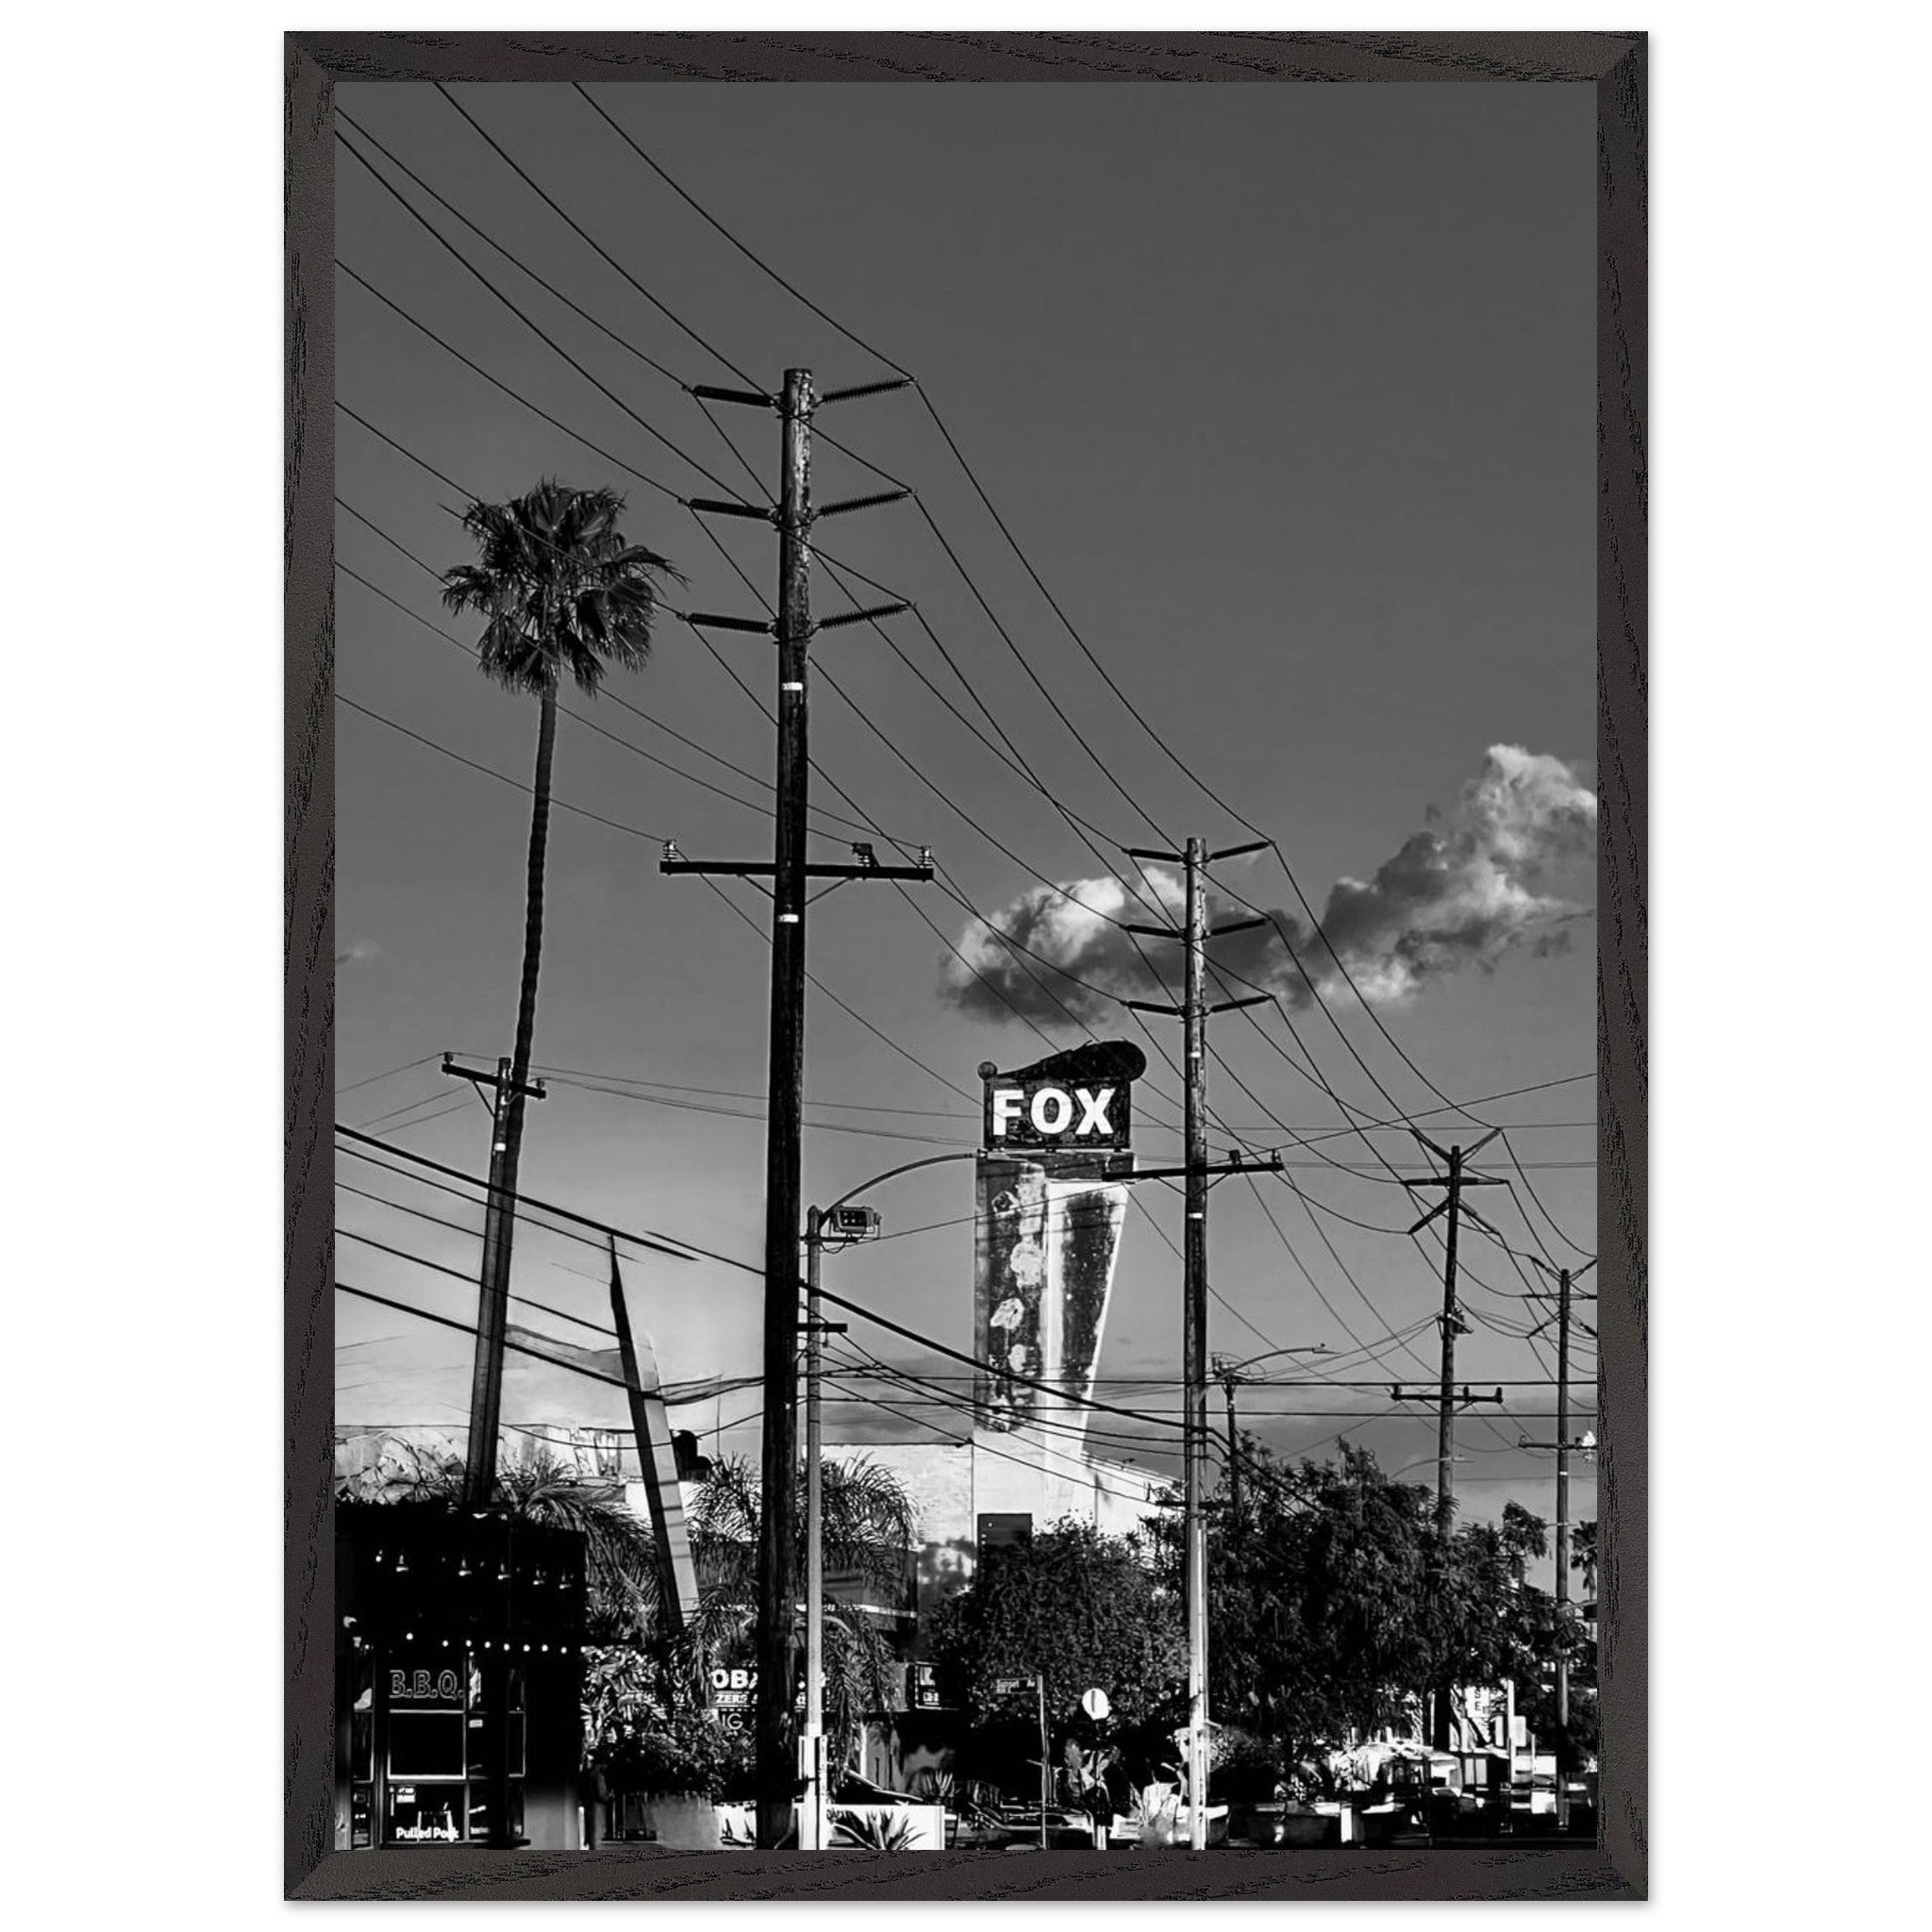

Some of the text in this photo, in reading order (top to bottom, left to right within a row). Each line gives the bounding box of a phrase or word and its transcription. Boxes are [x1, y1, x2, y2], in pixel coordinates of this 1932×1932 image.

[993, 1088, 1116, 1136] FOX
[389, 1669, 465, 1701] B.B.Q.
[433, 1826, 459, 1840] Pok
